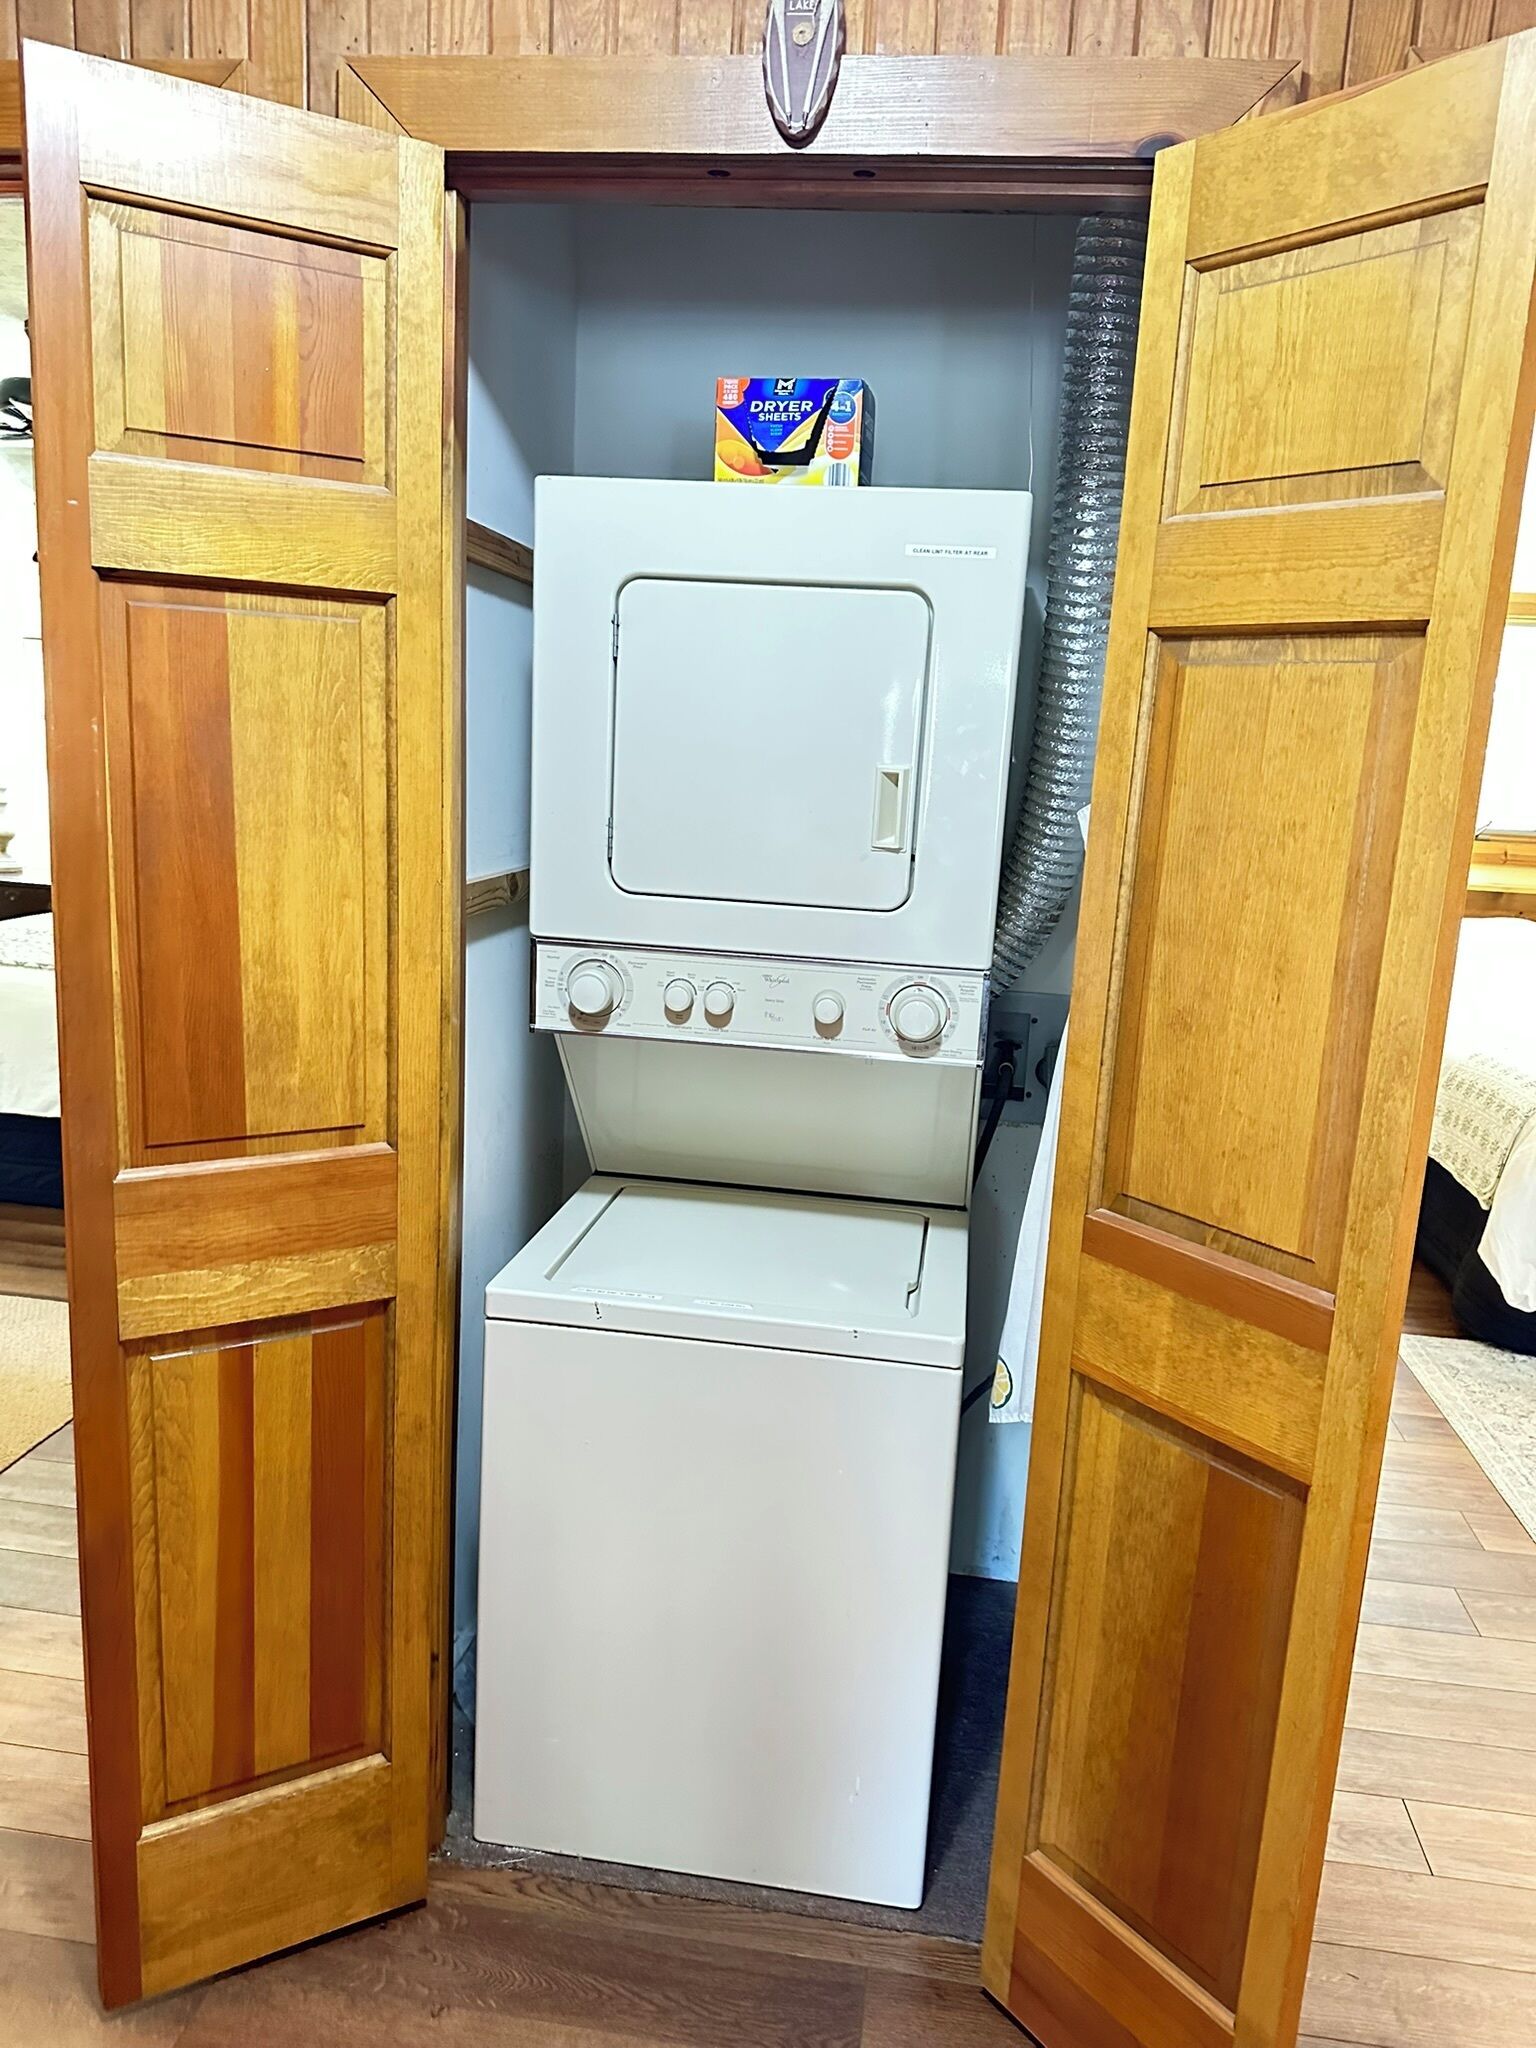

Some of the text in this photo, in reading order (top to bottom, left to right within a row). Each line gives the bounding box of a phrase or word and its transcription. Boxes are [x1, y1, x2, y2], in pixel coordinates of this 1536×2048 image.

[789, 0, 815, 10] LAKE
[750, 400, 814, 412] DRYER
[758, 412, 802, 421] SHEETS
